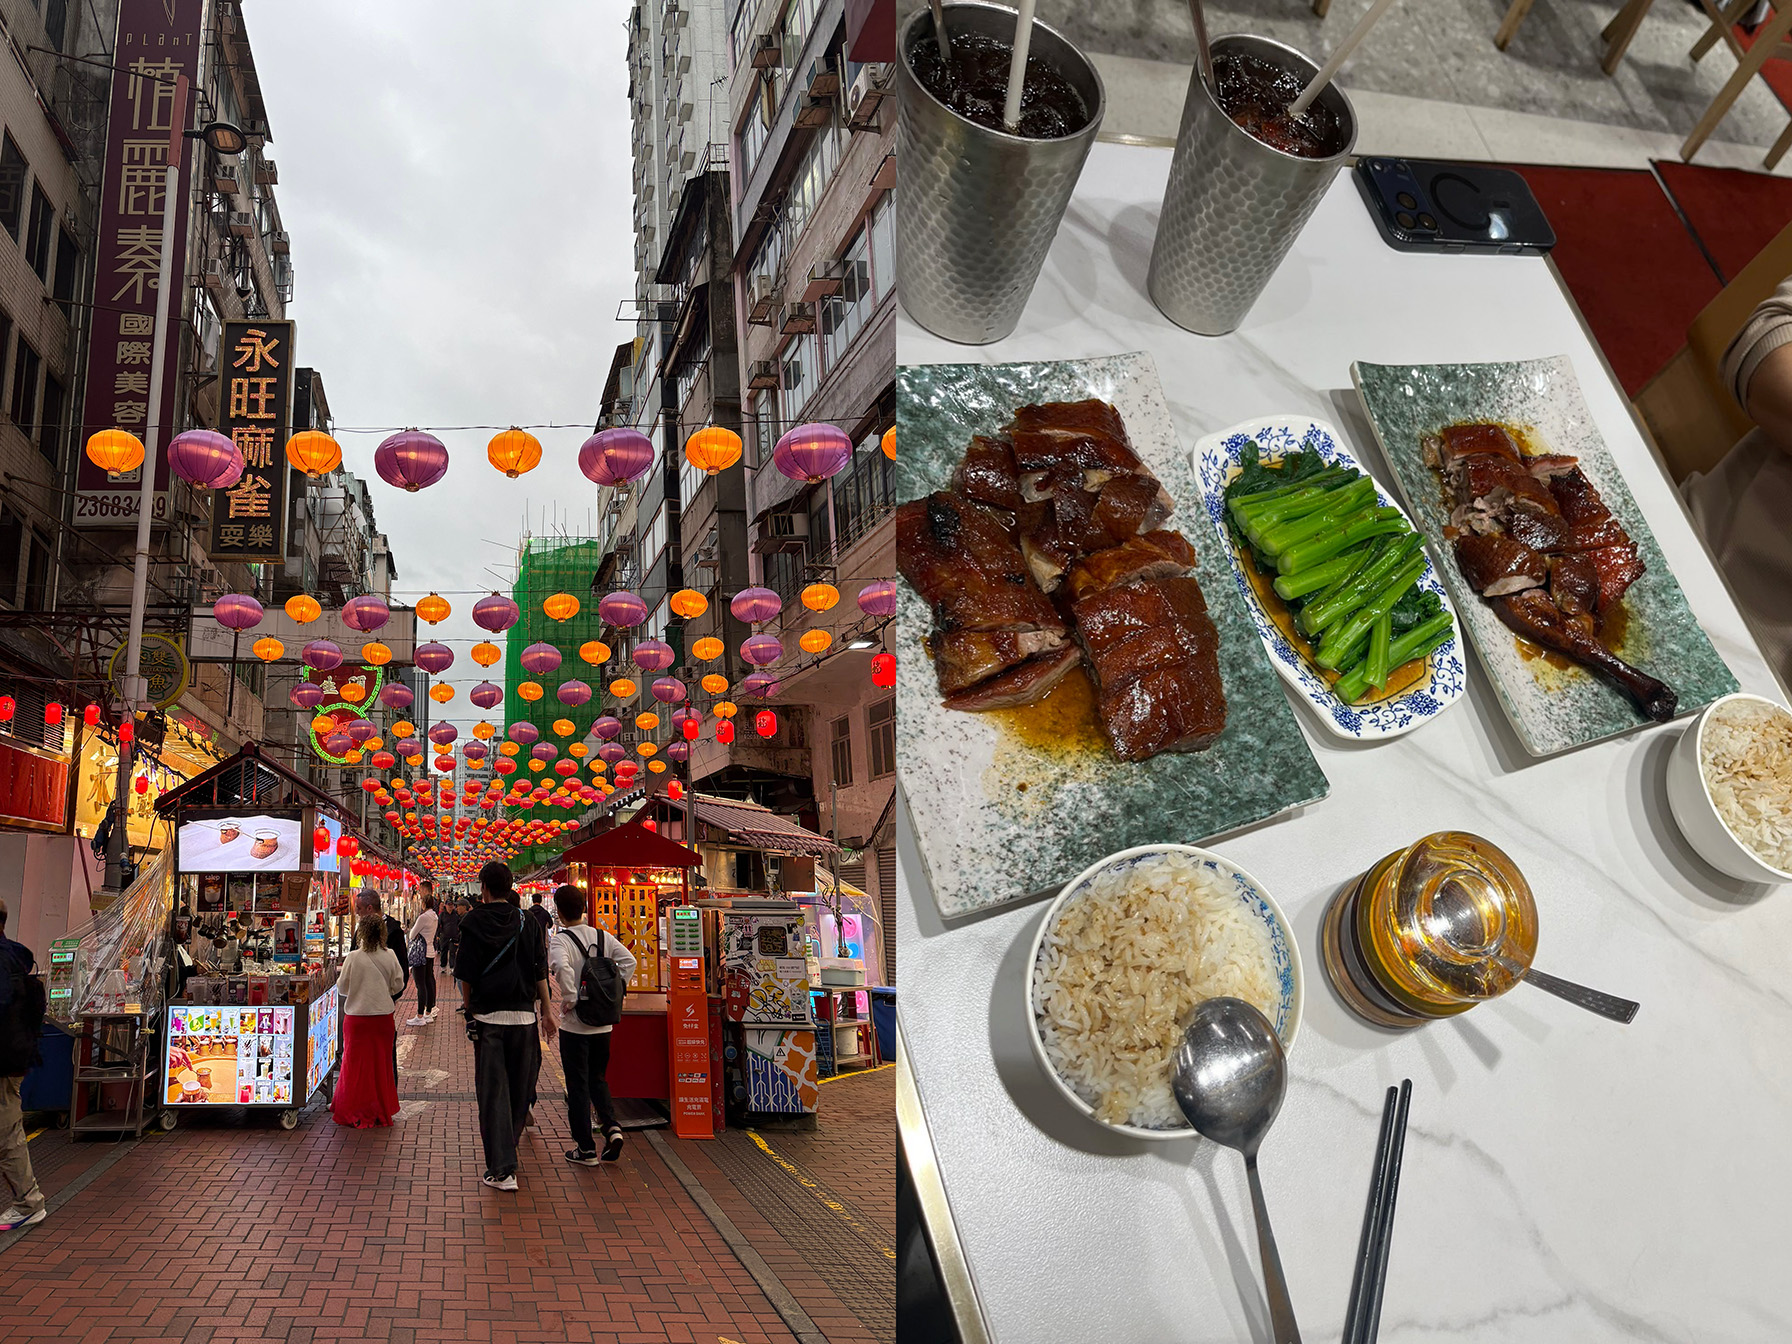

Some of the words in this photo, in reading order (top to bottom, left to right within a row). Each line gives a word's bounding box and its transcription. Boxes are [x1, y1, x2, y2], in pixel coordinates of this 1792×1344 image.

[225, 328, 280, 519] 永旺麻雀
[219, 524, 273, 548] 耍樂
